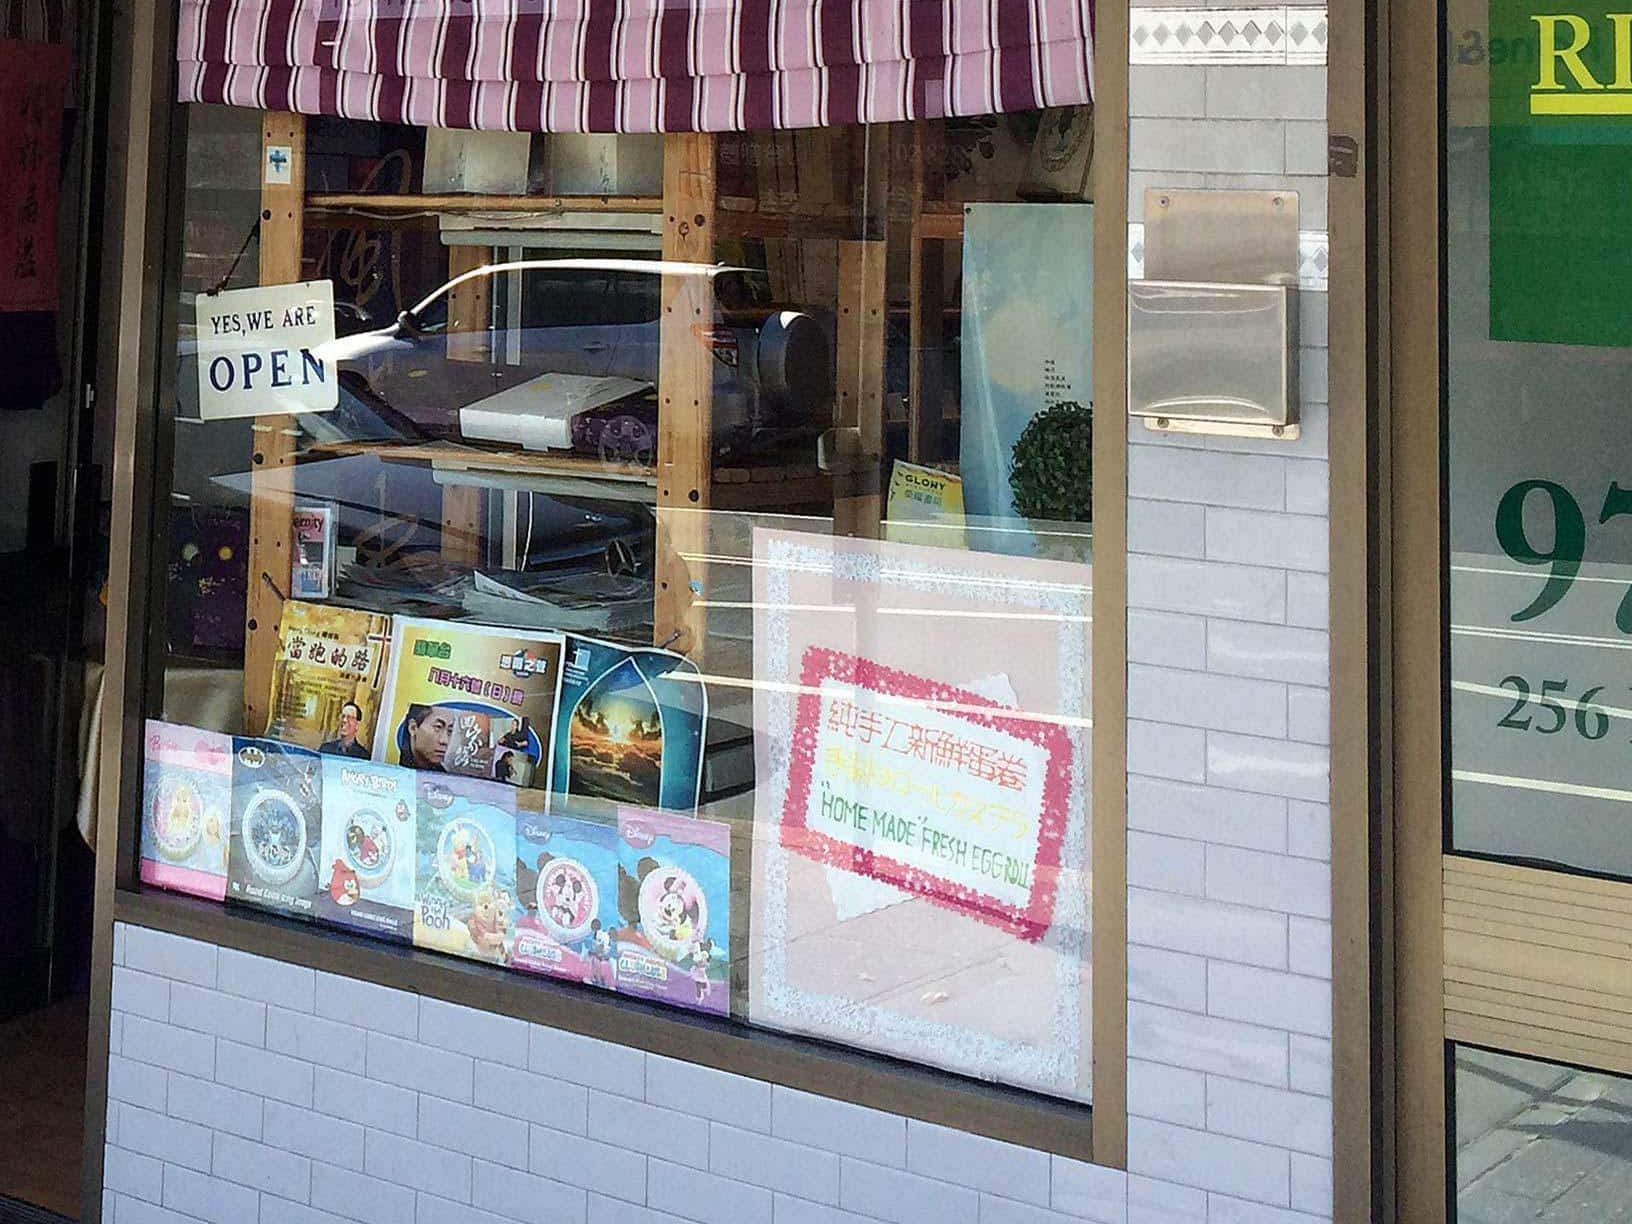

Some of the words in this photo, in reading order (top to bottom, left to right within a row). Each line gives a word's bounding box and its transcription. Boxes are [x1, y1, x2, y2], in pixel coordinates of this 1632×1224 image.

[283, 306, 316, 327] ARE
[210, 348, 325, 391] OPEN
[1497, 675, 1610, 740] 256
[921, 825, 968, 868] FRESH
[421, 905, 451, 930] Pooh
